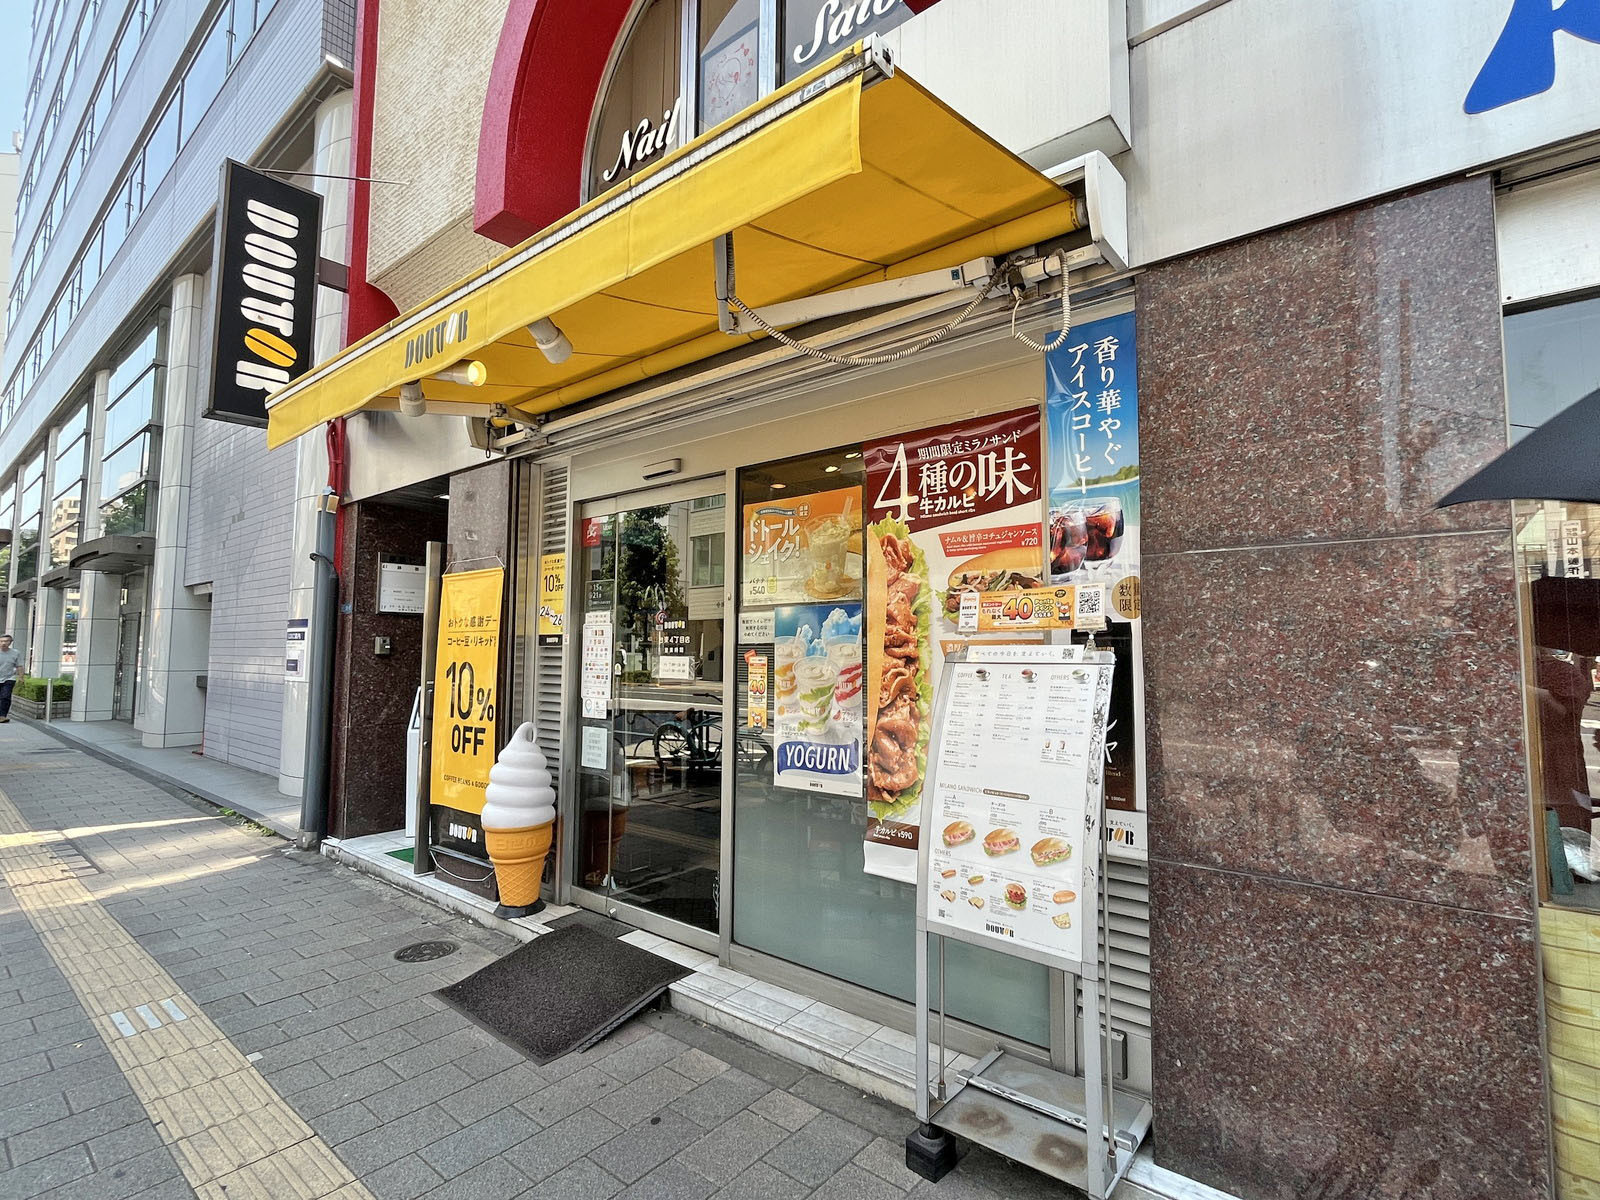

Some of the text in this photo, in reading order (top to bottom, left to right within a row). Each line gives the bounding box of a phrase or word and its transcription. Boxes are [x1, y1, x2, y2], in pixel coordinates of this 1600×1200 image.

[603, 97, 681, 182] Nail
[236, 199, 299, 393] DOUTOR
[404, 309, 468, 369] DOUTOR
[1093, 336, 1122, 465] 香り華やぐ
[1068, 343, 1092, 495] アイスコーヒー
[917, 429, 1021, 461] 期間限定ミラノサンド
[919, 492, 977, 515] 牛カルビ
[750, 518, 800, 542] ドトール
[1021, 537, 1038, 546] ¥720
[1002, 596, 1034, 620] 40
[446, 661, 494, 722] 10%
[451, 724, 485, 756] OFF
[786, 744, 850, 771] YOGURN
[449, 822, 477, 843] DOUTOR
